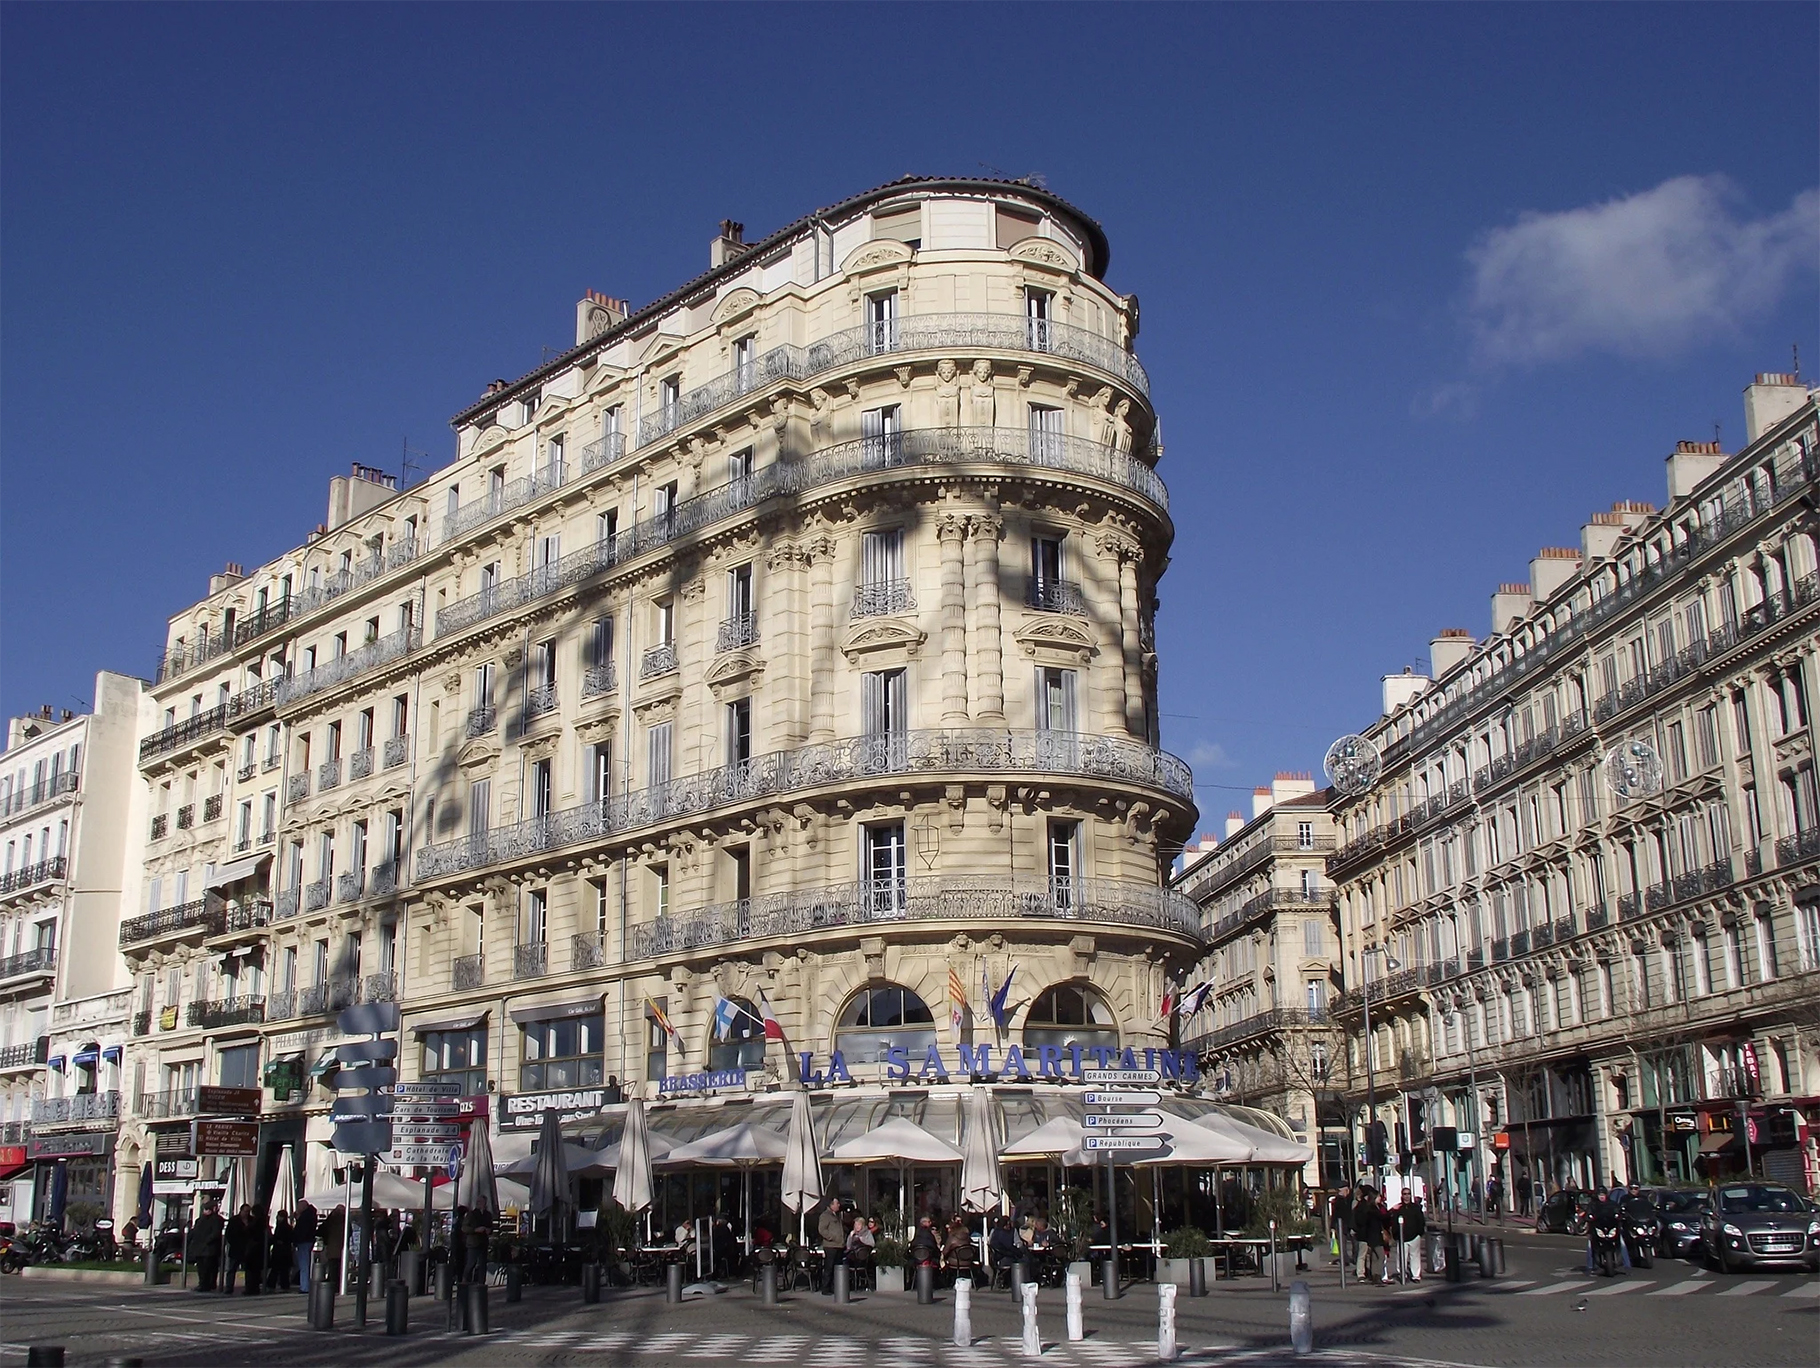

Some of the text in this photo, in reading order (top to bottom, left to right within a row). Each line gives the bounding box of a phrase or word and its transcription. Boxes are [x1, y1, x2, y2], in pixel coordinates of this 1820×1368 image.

[275, 1031, 325, 1048] PHARMACIE
[800, 1044, 1199, 1083] LA SAMARITAINE
[1744, 1043, 1757, 1078] TABAC
[659, 1070, 745, 1092] BRASSERIE
[1087, 1072, 1153, 1080] GRANDS CARMES
[508, 1091, 605, 1113] RESTAURANT
[159, 1161, 176, 1173] DESS
